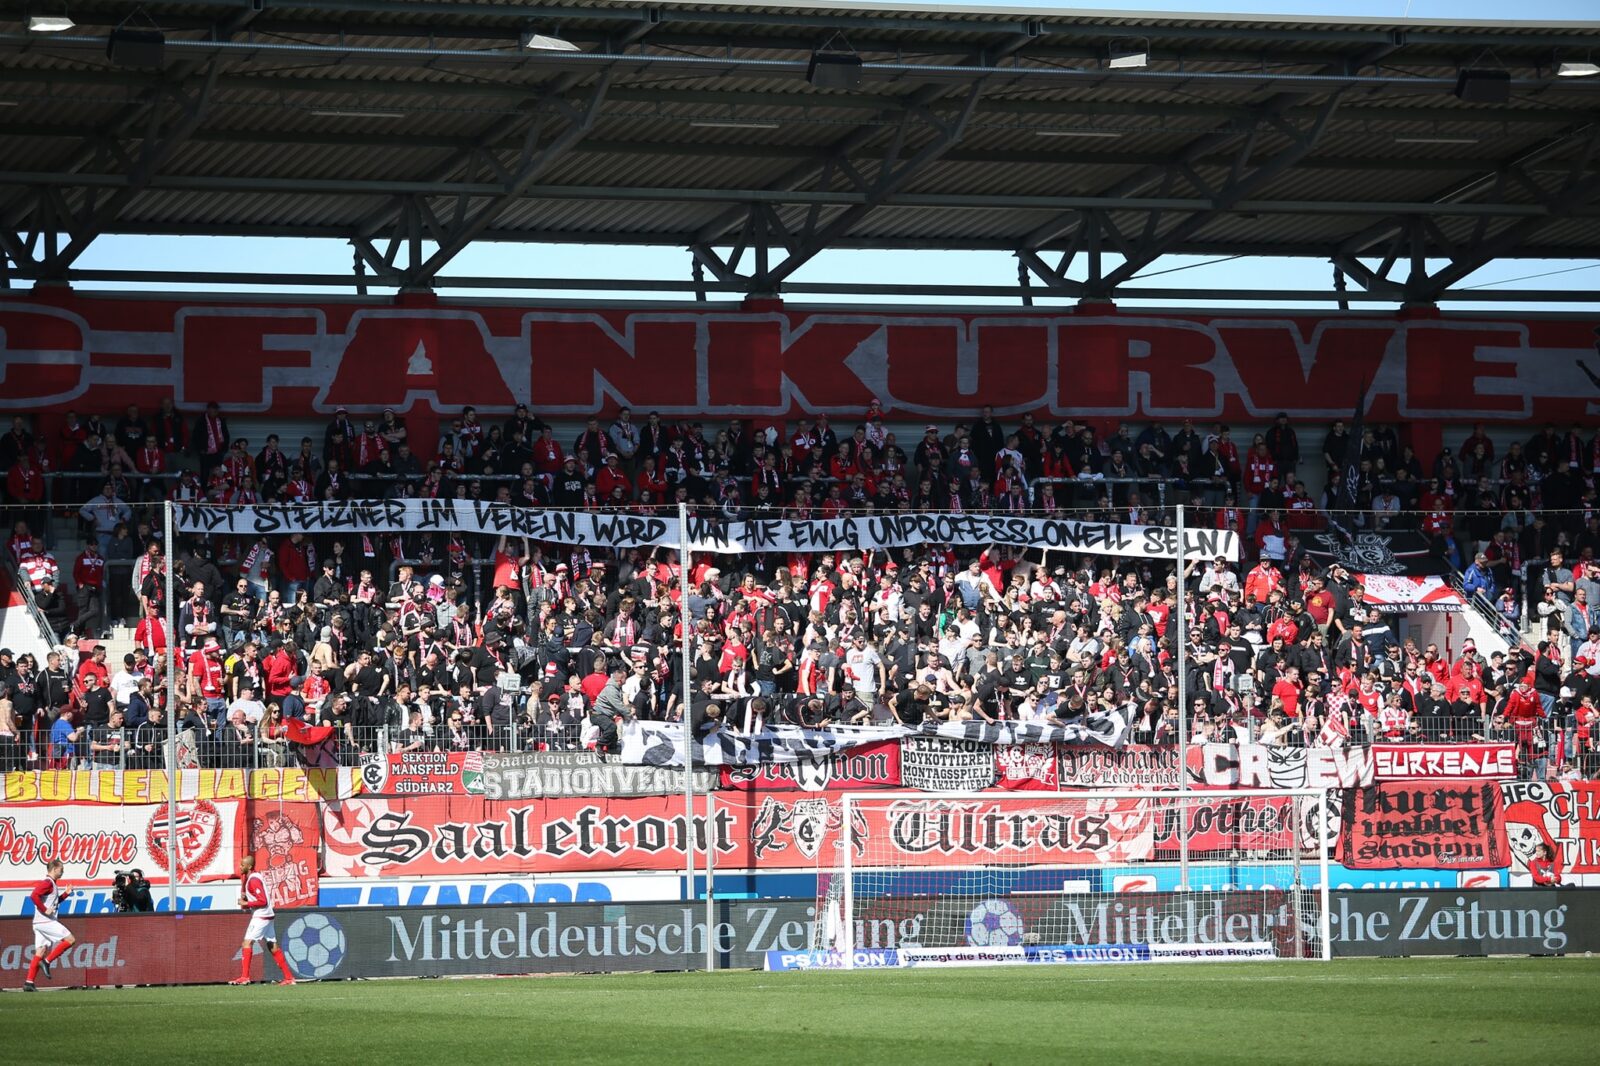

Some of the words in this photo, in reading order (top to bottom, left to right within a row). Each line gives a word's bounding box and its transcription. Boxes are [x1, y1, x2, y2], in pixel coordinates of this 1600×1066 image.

[254, 500, 406, 532] STELZNER
[416, 500, 459, 529] IM
[473, 500, 586, 545] VEREIN,
[591, 513, 667, 547] WIRD
[735, 519, 783, 547] AUF
[788, 518, 859, 549] EWIG
[868, 514, 1132, 550] UNPROFESSIONELL
[1400, 604, 1415, 612] UM
[1417, 604, 1430, 612] ZU
[401, 753, 448, 763] SEKTION
[575, 752, 622, 765] Ultra
[902, 751, 991, 767] BOYKOTTIEREN
[1376, 750, 1514, 775] SURREALE
[391, 763, 460, 776] MANSFELD
[902, 764, 991, 779] MONTAGSSPIELE
[5, 769, 177, 803] BULLEN
[395, 778, 453, 793] SÜDHARZ
[902, 776, 932, 789] NICHT
[932, 778, 991, 791] AKZEPTIEREN
[1502, 783, 1544, 805] HFC
[1549, 790, 1600, 825] CH
[361, 804, 738, 864] Saalefront
[886, 799, 1112, 856] Ultras
[39, 817, 138, 878] Sempre
[271, 877, 317, 908] ALLE
[1398, 896, 1568, 950] Zeitung
[385, 908, 736, 962] Mitteldeutsche
[745, 906, 924, 952] Zeing
[781, 954, 812, 968] PS
[816, 952, 887, 967] UNON
[903, 952, 956, 963] bewegt
[956, 951, 977, 961] die
[978, 951, 1025, 963] Region
[1037, 950, 1067, 963] PS
[1068, 948, 1139, 962] UNION
[1153, 949, 1203, 959] bewegt
[1206, 948, 1225, 957] die
[1227, 948, 1273, 960] Region
